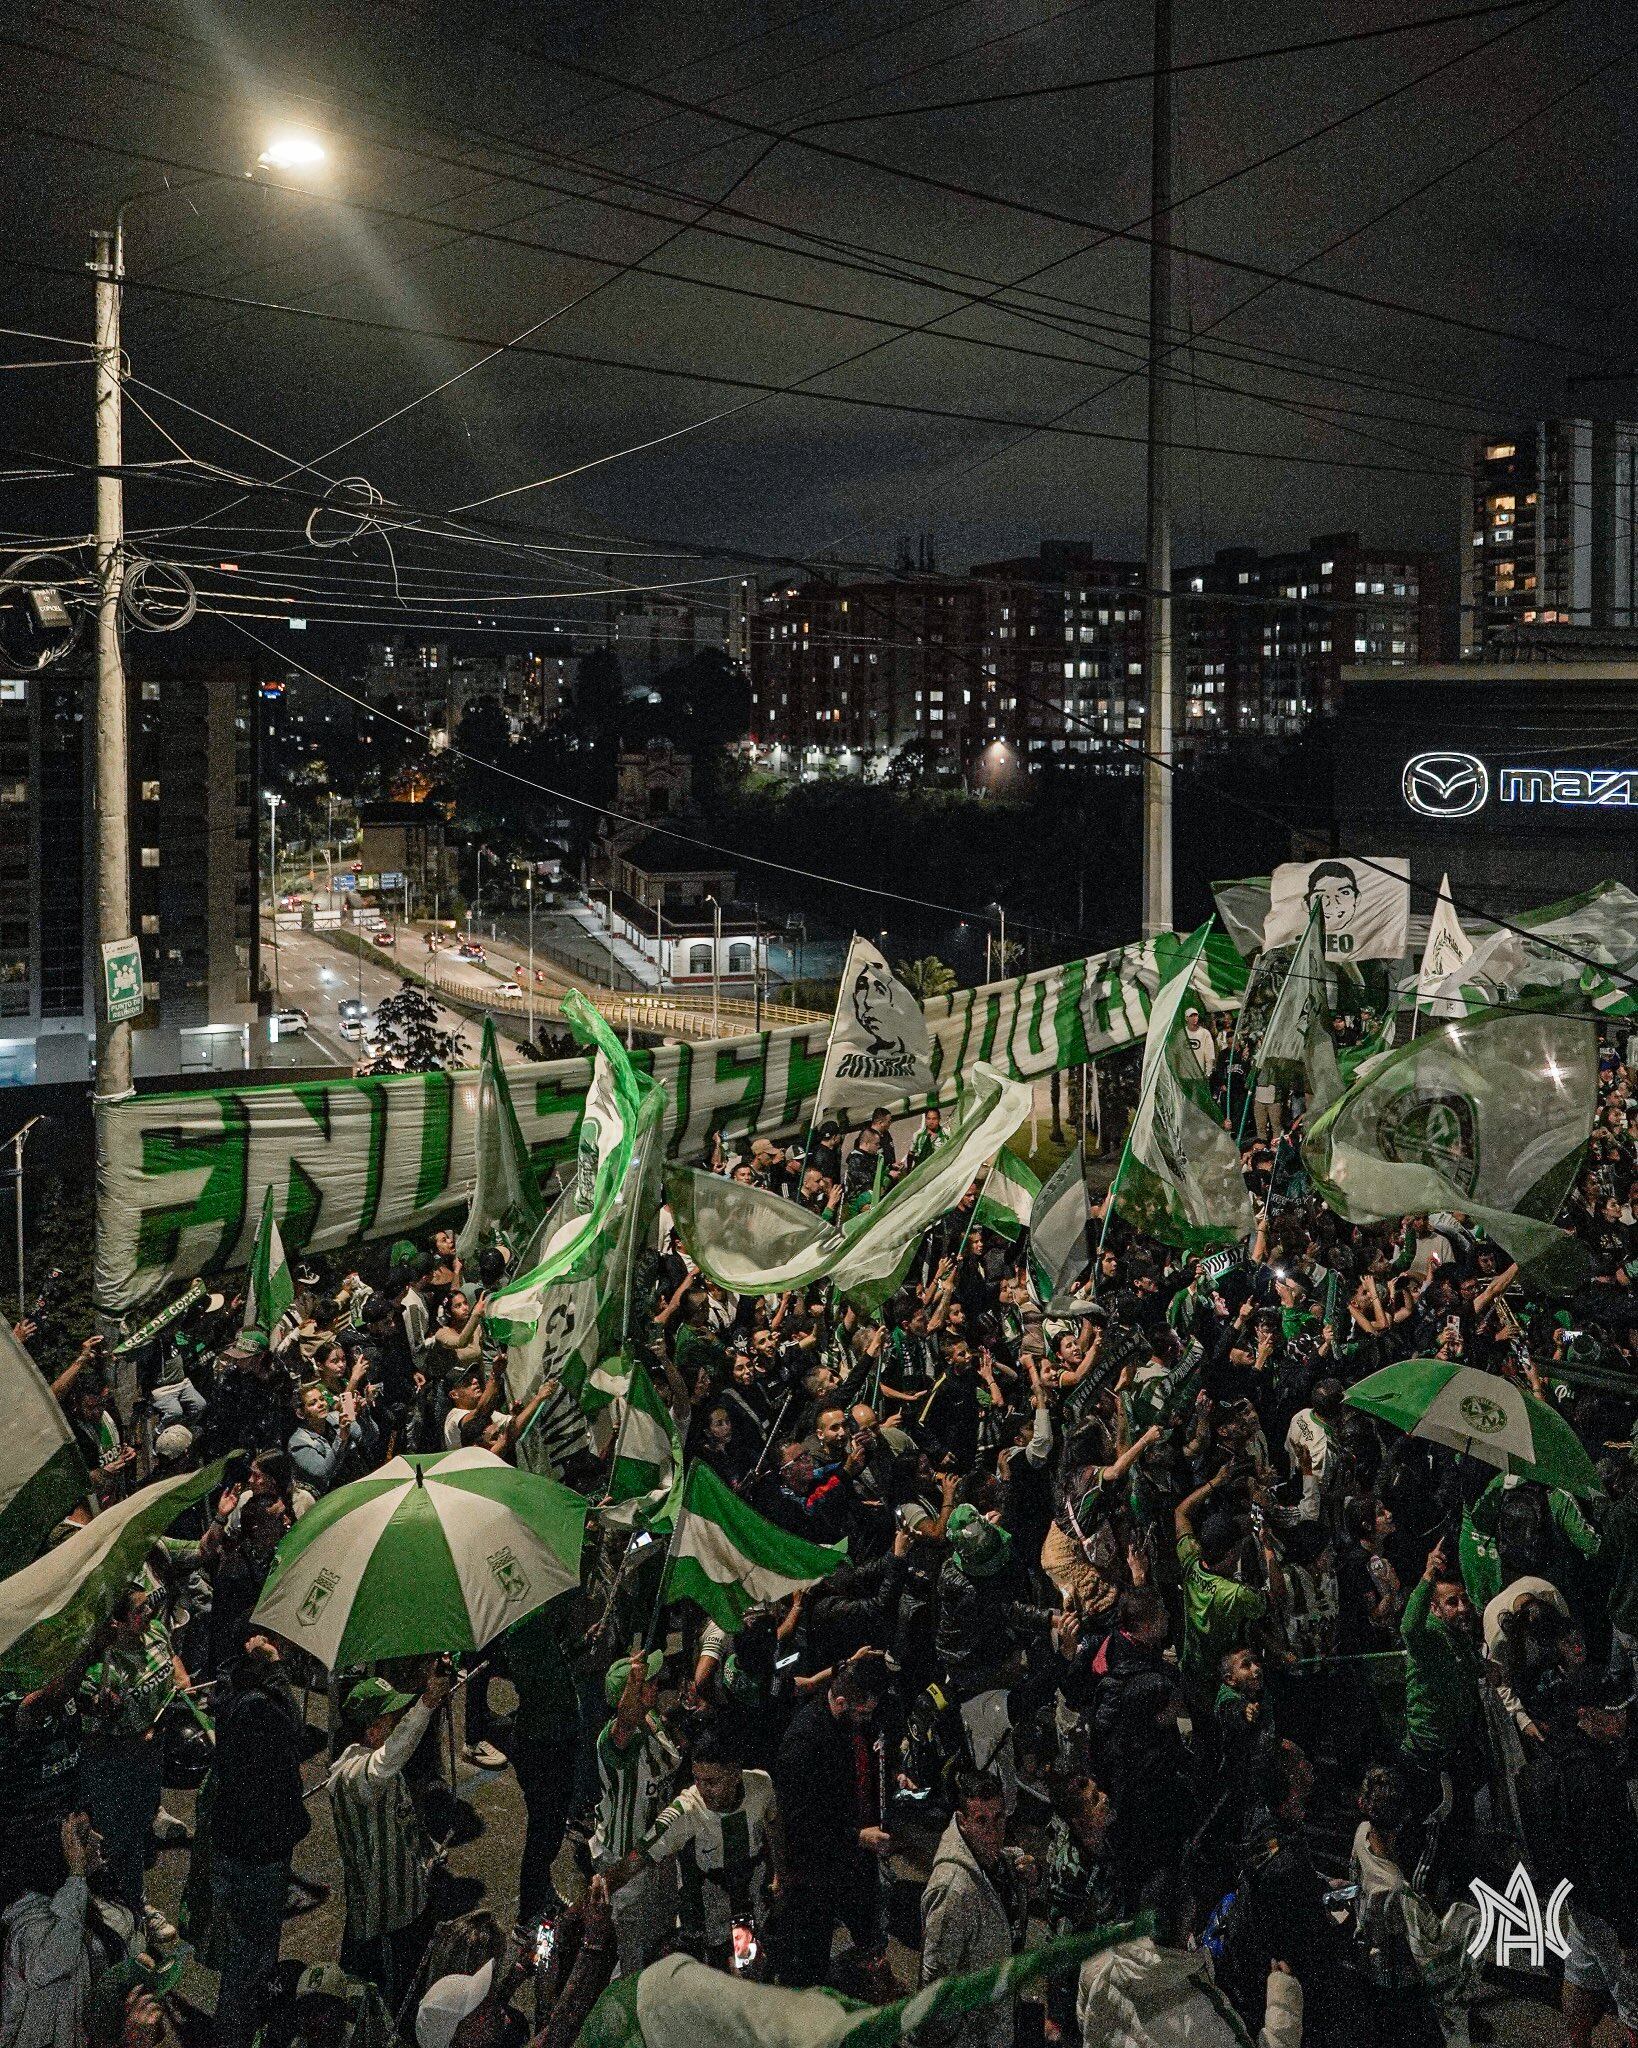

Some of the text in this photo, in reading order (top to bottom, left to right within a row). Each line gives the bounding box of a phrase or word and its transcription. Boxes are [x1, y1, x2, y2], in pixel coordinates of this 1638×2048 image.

[110, 1001, 132, 1012] PUNTO
[124, 1286, 201, 1348] REY DE COPAS
